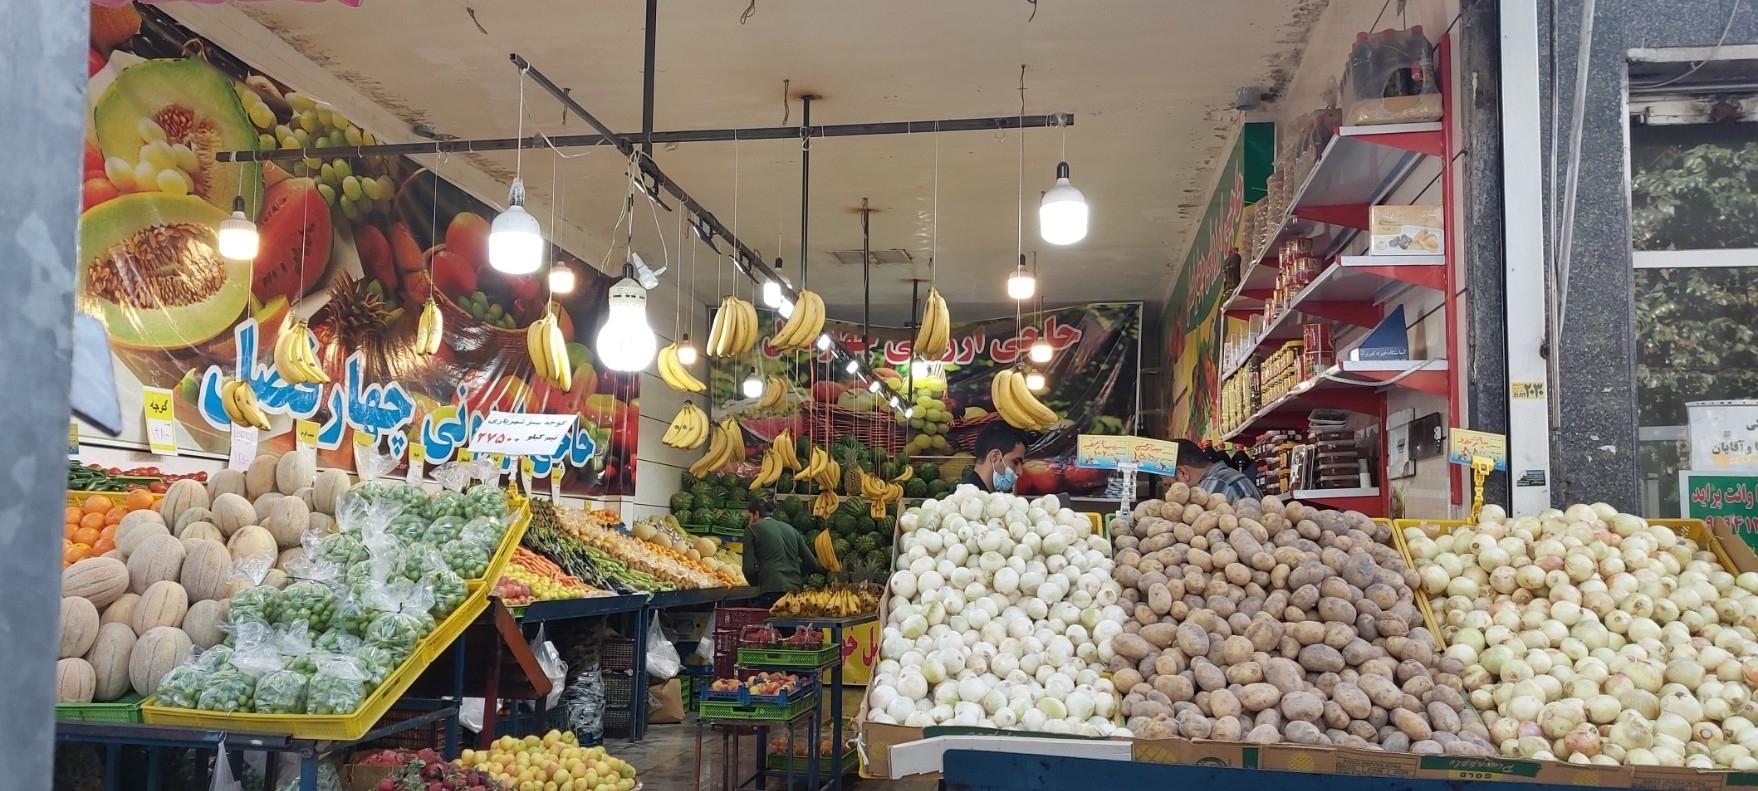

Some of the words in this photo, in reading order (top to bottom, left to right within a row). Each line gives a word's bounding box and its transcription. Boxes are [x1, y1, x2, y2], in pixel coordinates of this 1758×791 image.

[884, 326, 986, 365] اری
[990, 315, 1082, 363] حاجی
[198, 318, 324, 431] فصل
[150, 400, 168, 414] گوجه
[317, 350, 416, 461] چهار
[421, 380, 528, 475] ونی
[526, 432, 545, 442] کیلو
[1712, 440, 1744, 455] آقایان
[1692, 483, 1723, 510] پراید
[1724, 483, 1754, 510] وانت
[1459, 772, 1492, 780] GOLD
